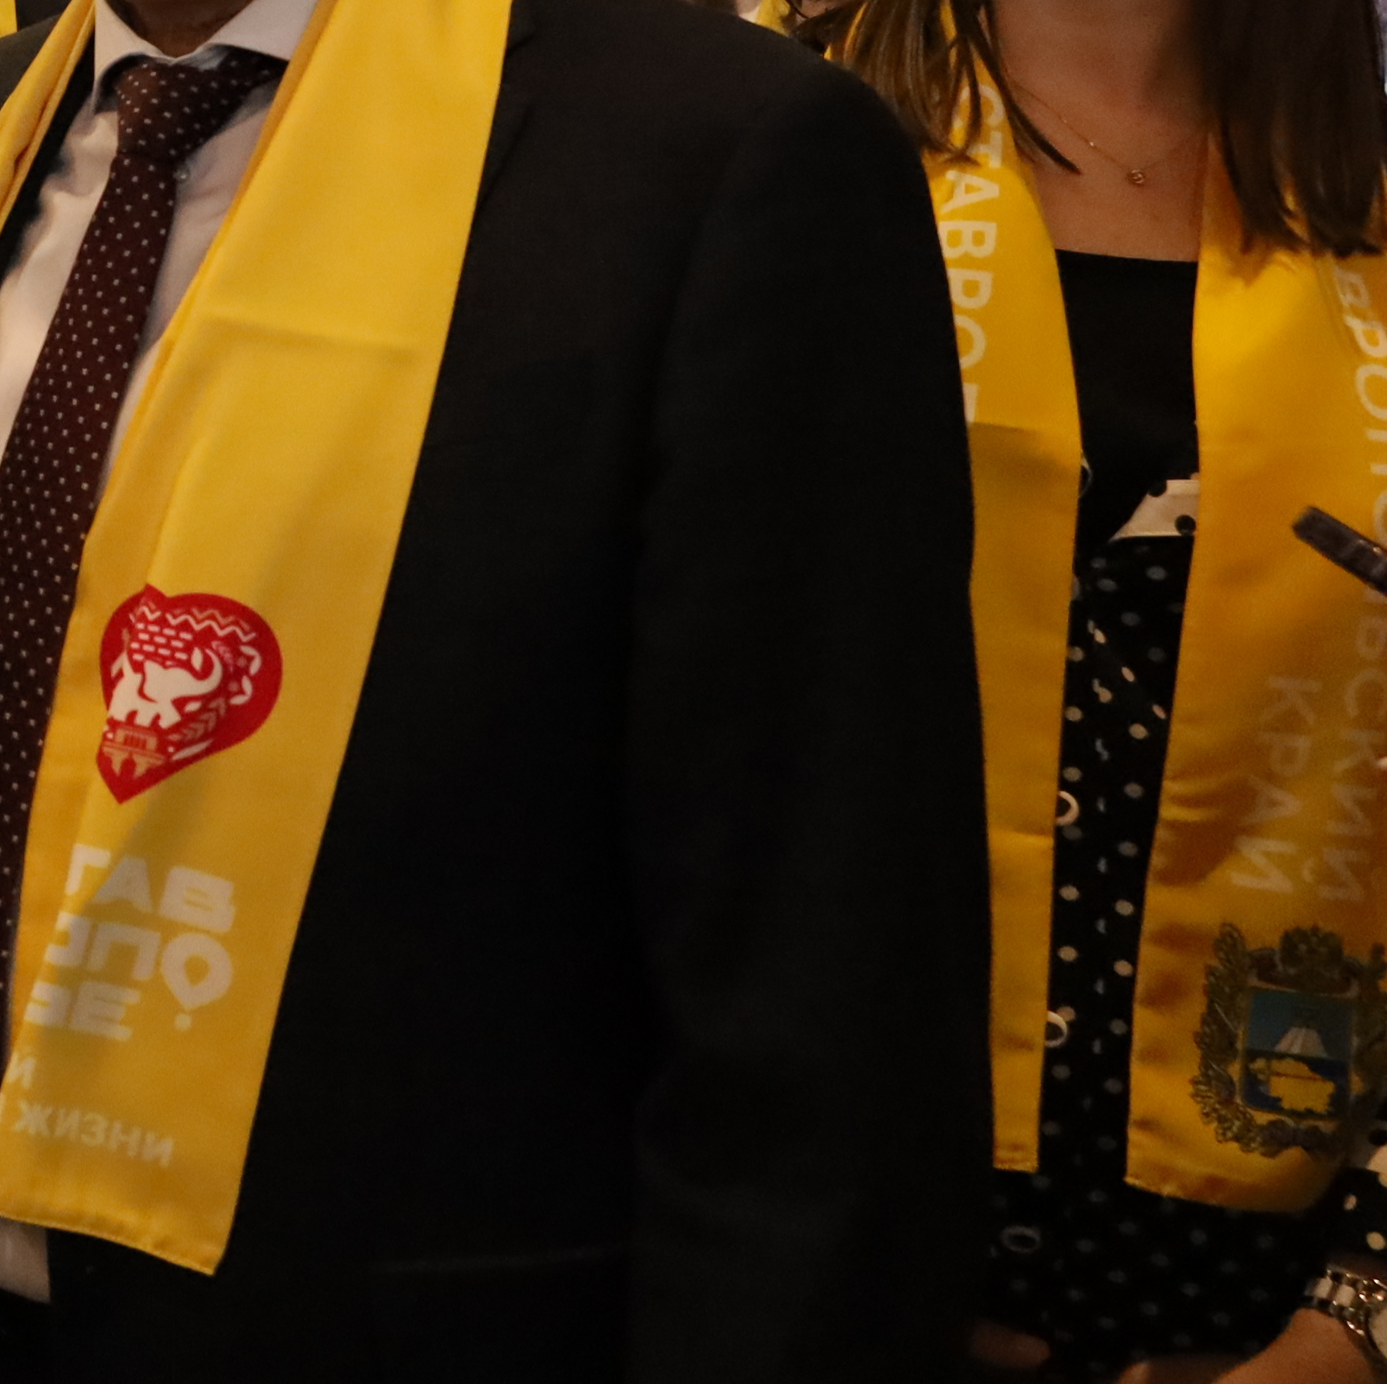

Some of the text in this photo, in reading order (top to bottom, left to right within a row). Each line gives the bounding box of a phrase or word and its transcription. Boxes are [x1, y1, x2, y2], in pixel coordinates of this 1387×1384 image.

[1229, 674, 1325, 896] КРАЙ
[63, 842, 238, 933] ТАВ
[11, 1098, 176, 1169] ЖИЗНИ
